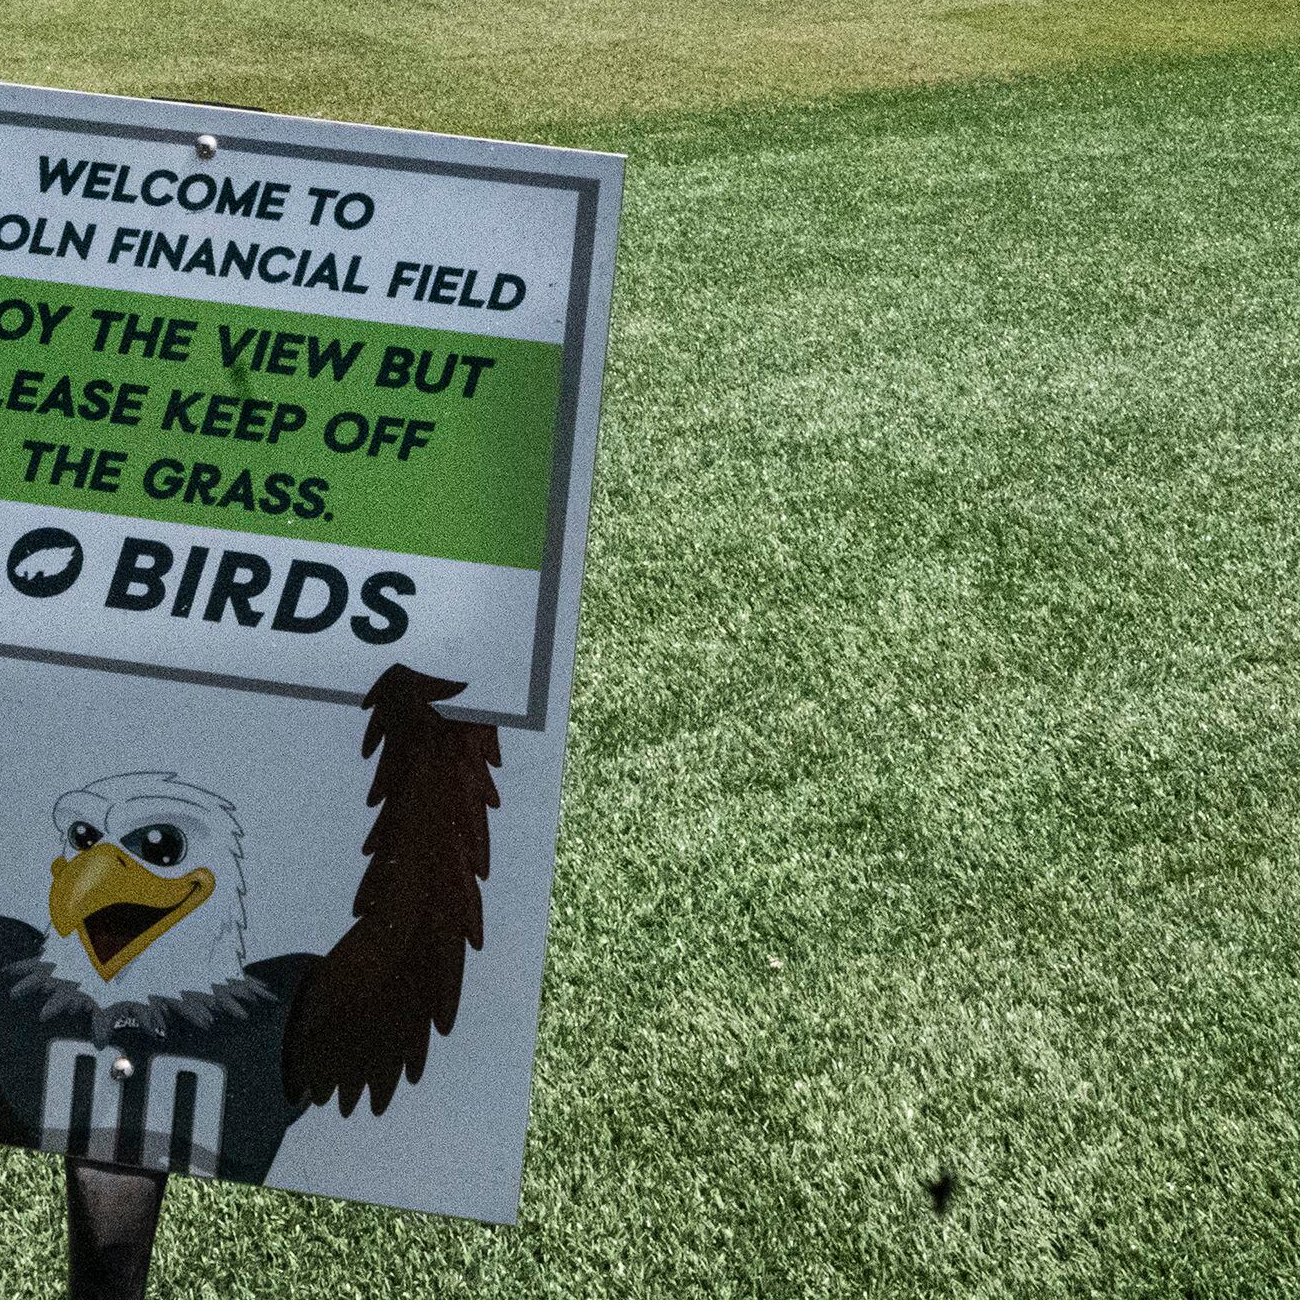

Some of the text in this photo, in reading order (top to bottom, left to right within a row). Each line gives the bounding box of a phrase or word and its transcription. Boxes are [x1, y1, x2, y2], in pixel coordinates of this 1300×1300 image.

[38, 155, 376, 231] WELCOME TO
[108, 227, 368, 295] FINANCIAL
[386, 261, 528, 312] FIELD
[89, 308, 199, 363] THE
[216, 324, 365, 383] VIEW
[373, 345, 498, 400] BUT
[159, 388, 308, 445] KEEP
[321, 410, 437, 462] OFF
[21, 438, 336, 522] THE GRASS.
[105, 536, 419, 647] BIRDS
